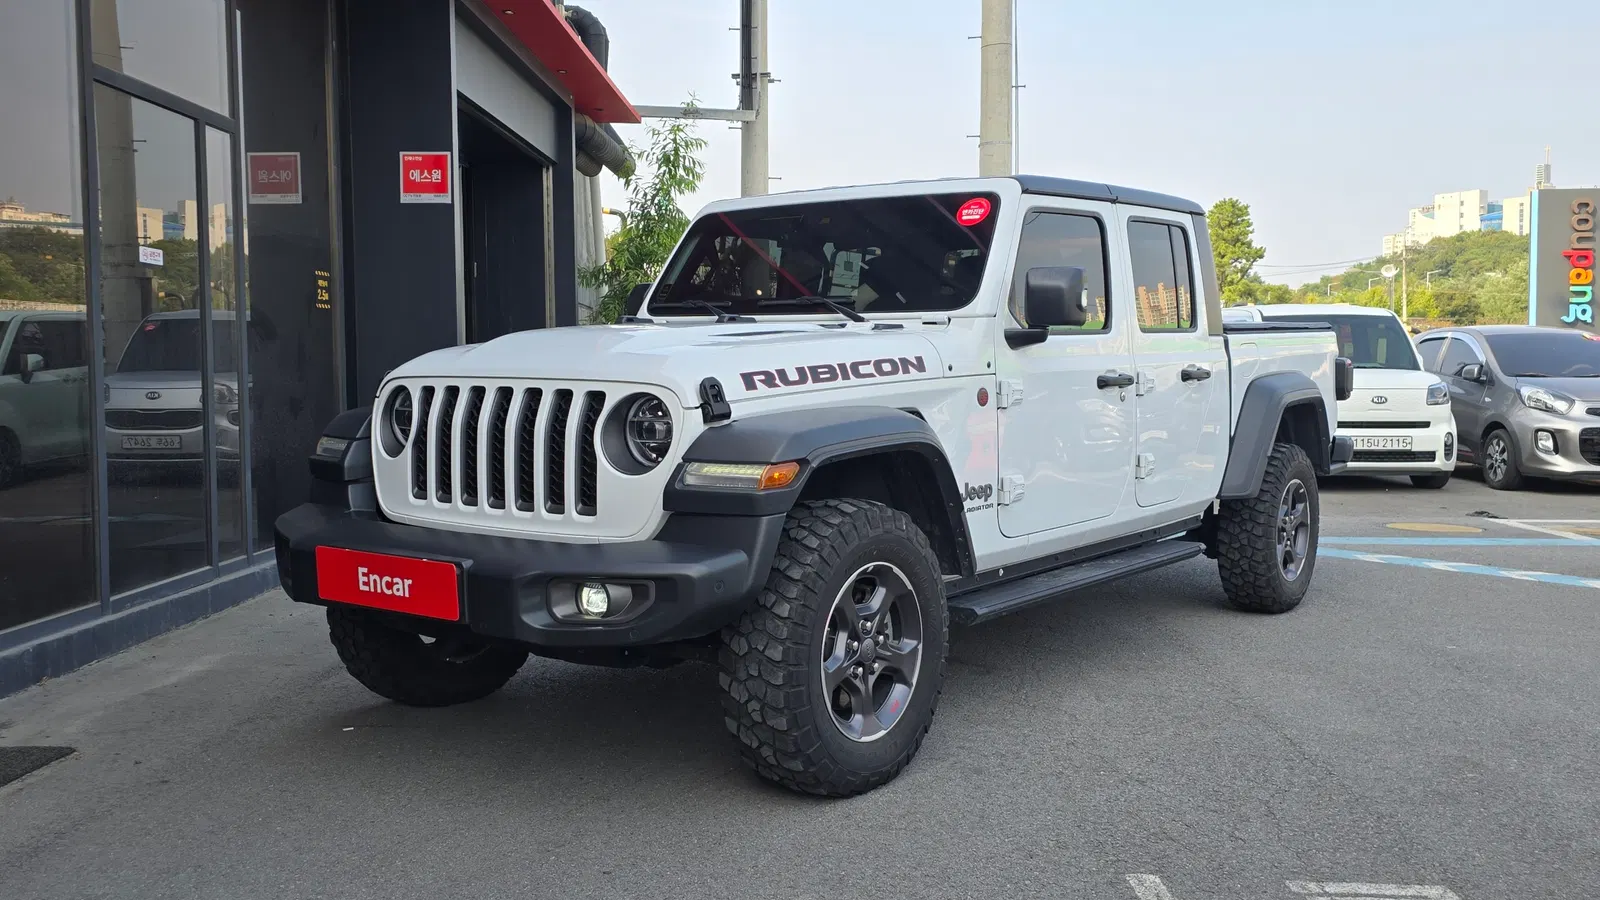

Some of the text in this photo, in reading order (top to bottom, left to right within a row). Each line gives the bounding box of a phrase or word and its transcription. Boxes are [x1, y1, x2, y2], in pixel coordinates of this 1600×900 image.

[409, 169, 442, 183] 에스원
[1561, 198, 1595, 324] coupang
[739, 355, 927, 392] RUBICON
[1382, 438, 1408, 448] 2115
[960, 482, 993, 502] Jeep
[357, 566, 413, 598] Encar
